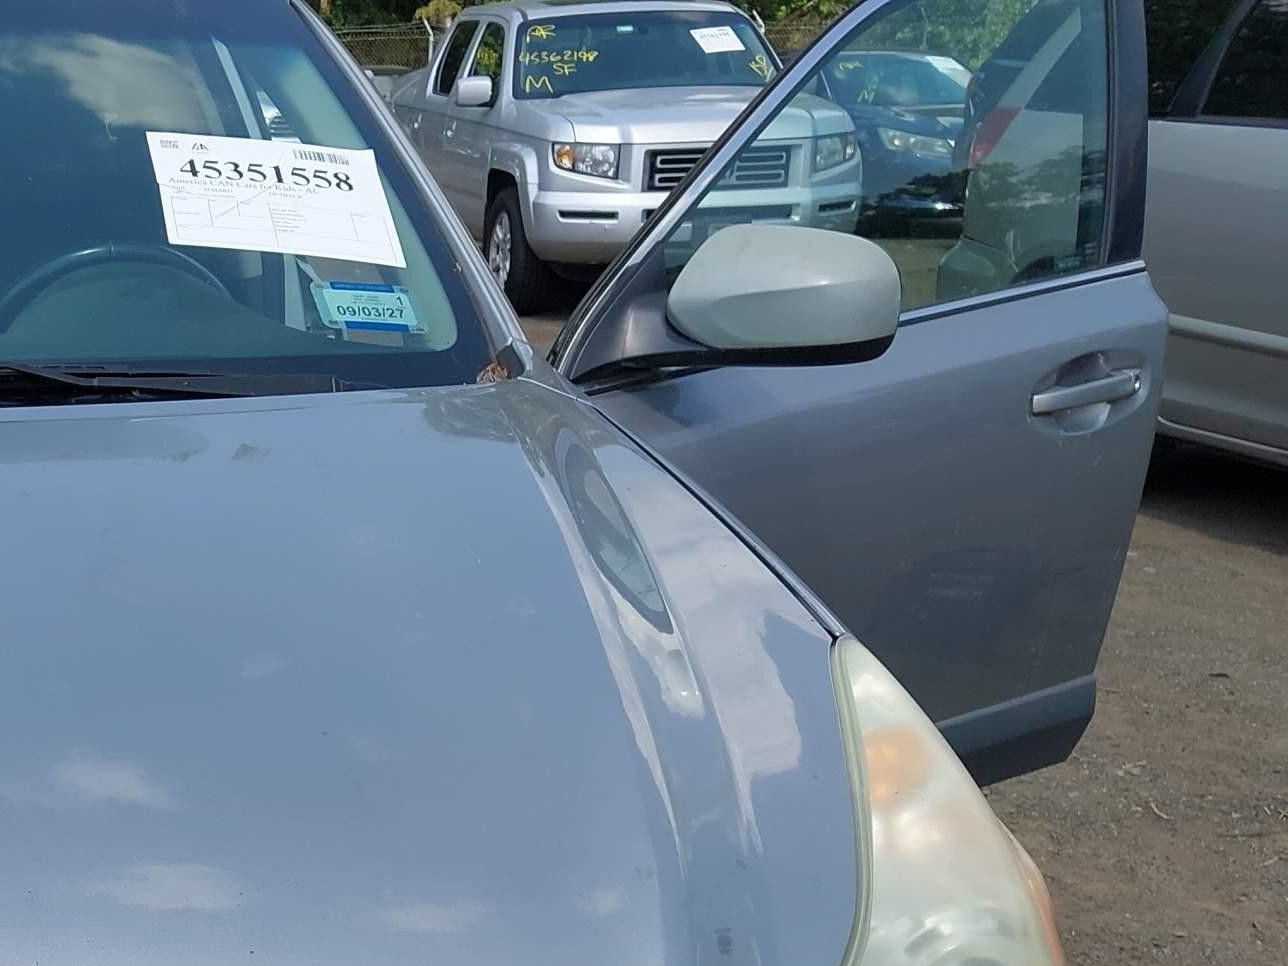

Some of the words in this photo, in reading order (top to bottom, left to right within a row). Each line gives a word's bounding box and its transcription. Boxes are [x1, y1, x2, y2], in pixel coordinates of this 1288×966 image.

[525, 75, 554, 94] M
[179, 158, 355, 193] 45351558
[396, 296, 404, 307] 1
[336, 304, 405, 320] 09/03/27
